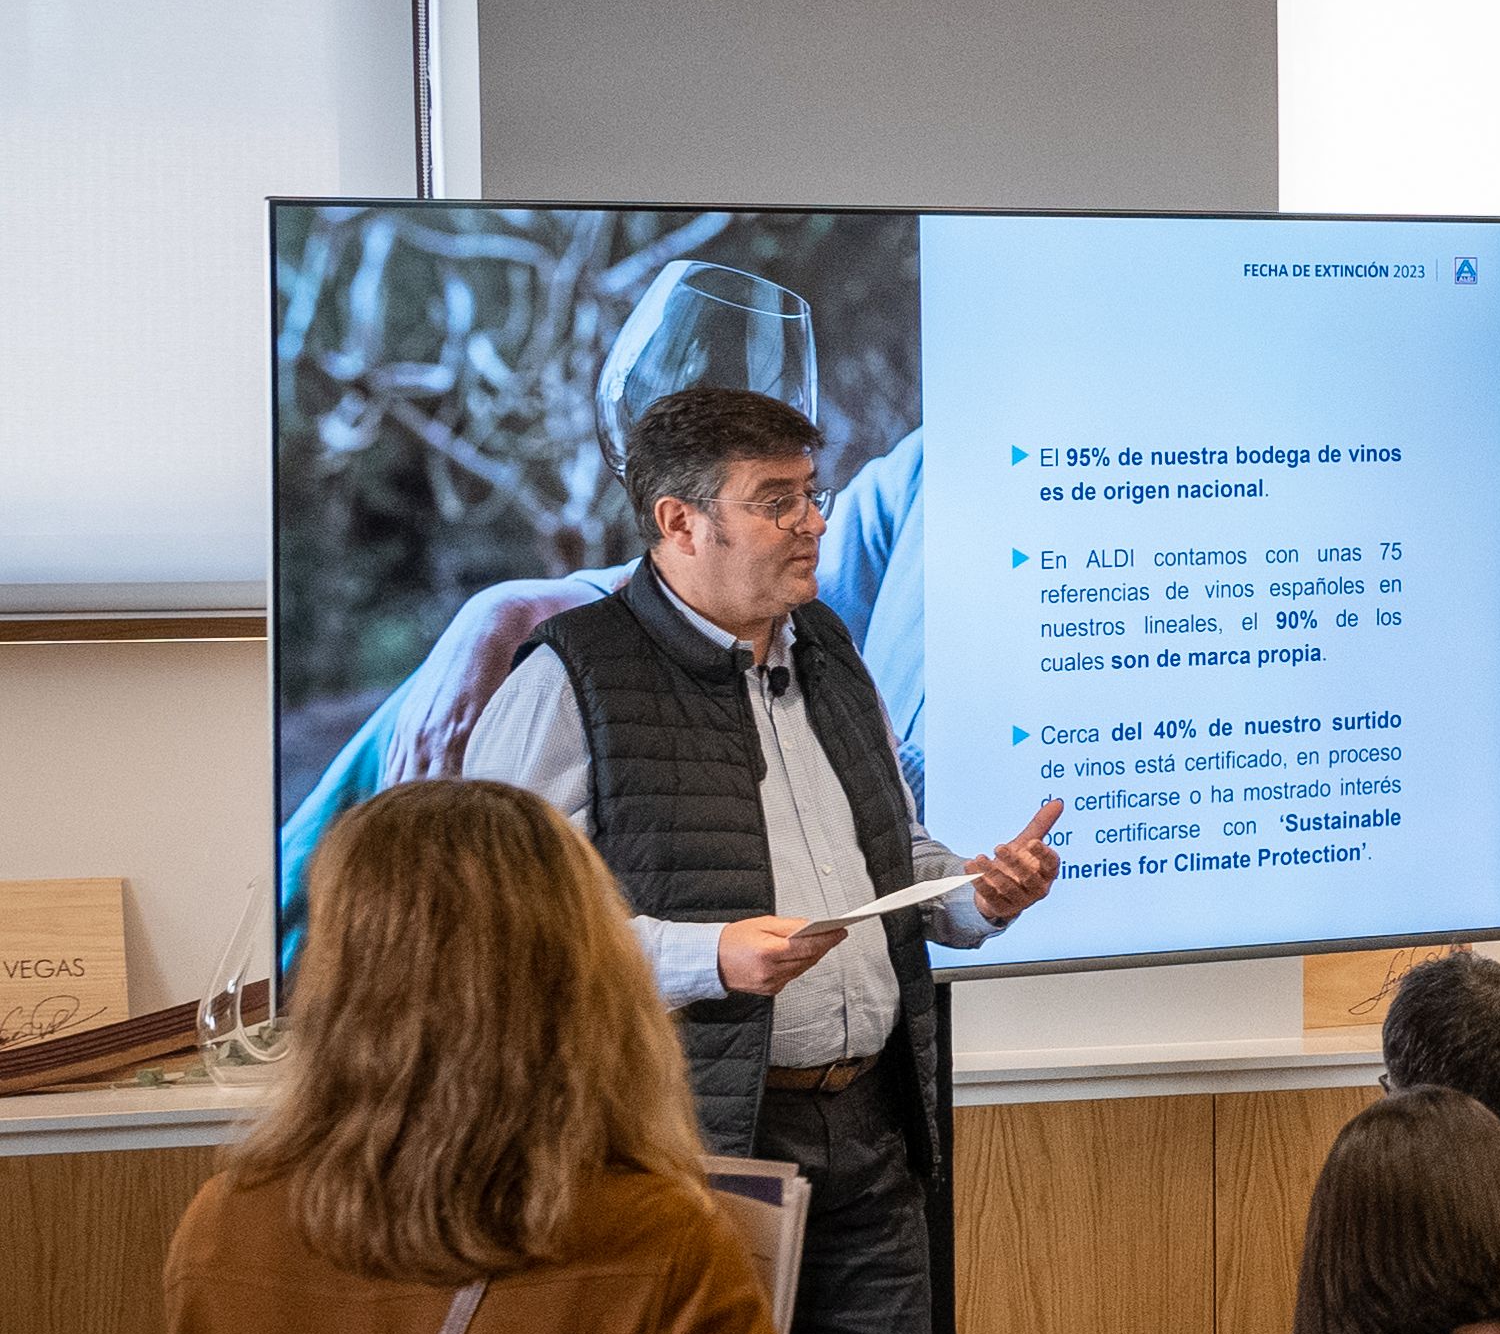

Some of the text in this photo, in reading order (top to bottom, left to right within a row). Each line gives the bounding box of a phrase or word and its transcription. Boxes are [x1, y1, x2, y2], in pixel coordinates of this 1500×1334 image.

[1243, 261, 1426, 279] FECHA DE EXTINCIÓN 2023
[1040, 444, 1402, 469] El 95% de nuestra bodega de vinos
[1039, 478, 1269, 505] es de origen nacional.
[1041, 541, 1403, 570] En ALDI contamos con unas 75
[1041, 575, 1402, 604] referencias de vinos españoles en
[1041, 607, 1402, 638] nuestros lineales, el 90% de los
[1040, 643, 1327, 673] cuales son de marca propia.
[1041, 710, 1402, 745] Cerca del 40% de nuestro surtido
[1040, 746, 1402, 779] de vinos está certificado, en proceso
[1074, 789, 1181, 812] certificarse
[1189, 789, 1202, 805] o
[1211, 784, 1234, 804] ha
[1243, 779, 1332, 802] mostrado
[1340, 775, 1402, 796] interés
[1095, 822, 1201, 844] certificarse
[1223, 820, 1257, 837] con
[1058, 857, 1132, 880] ineries
[1138, 855, 1169, 875] for
[1174, 850, 1251, 872] Climate
[2, 957, 86, 979] VEGAS
